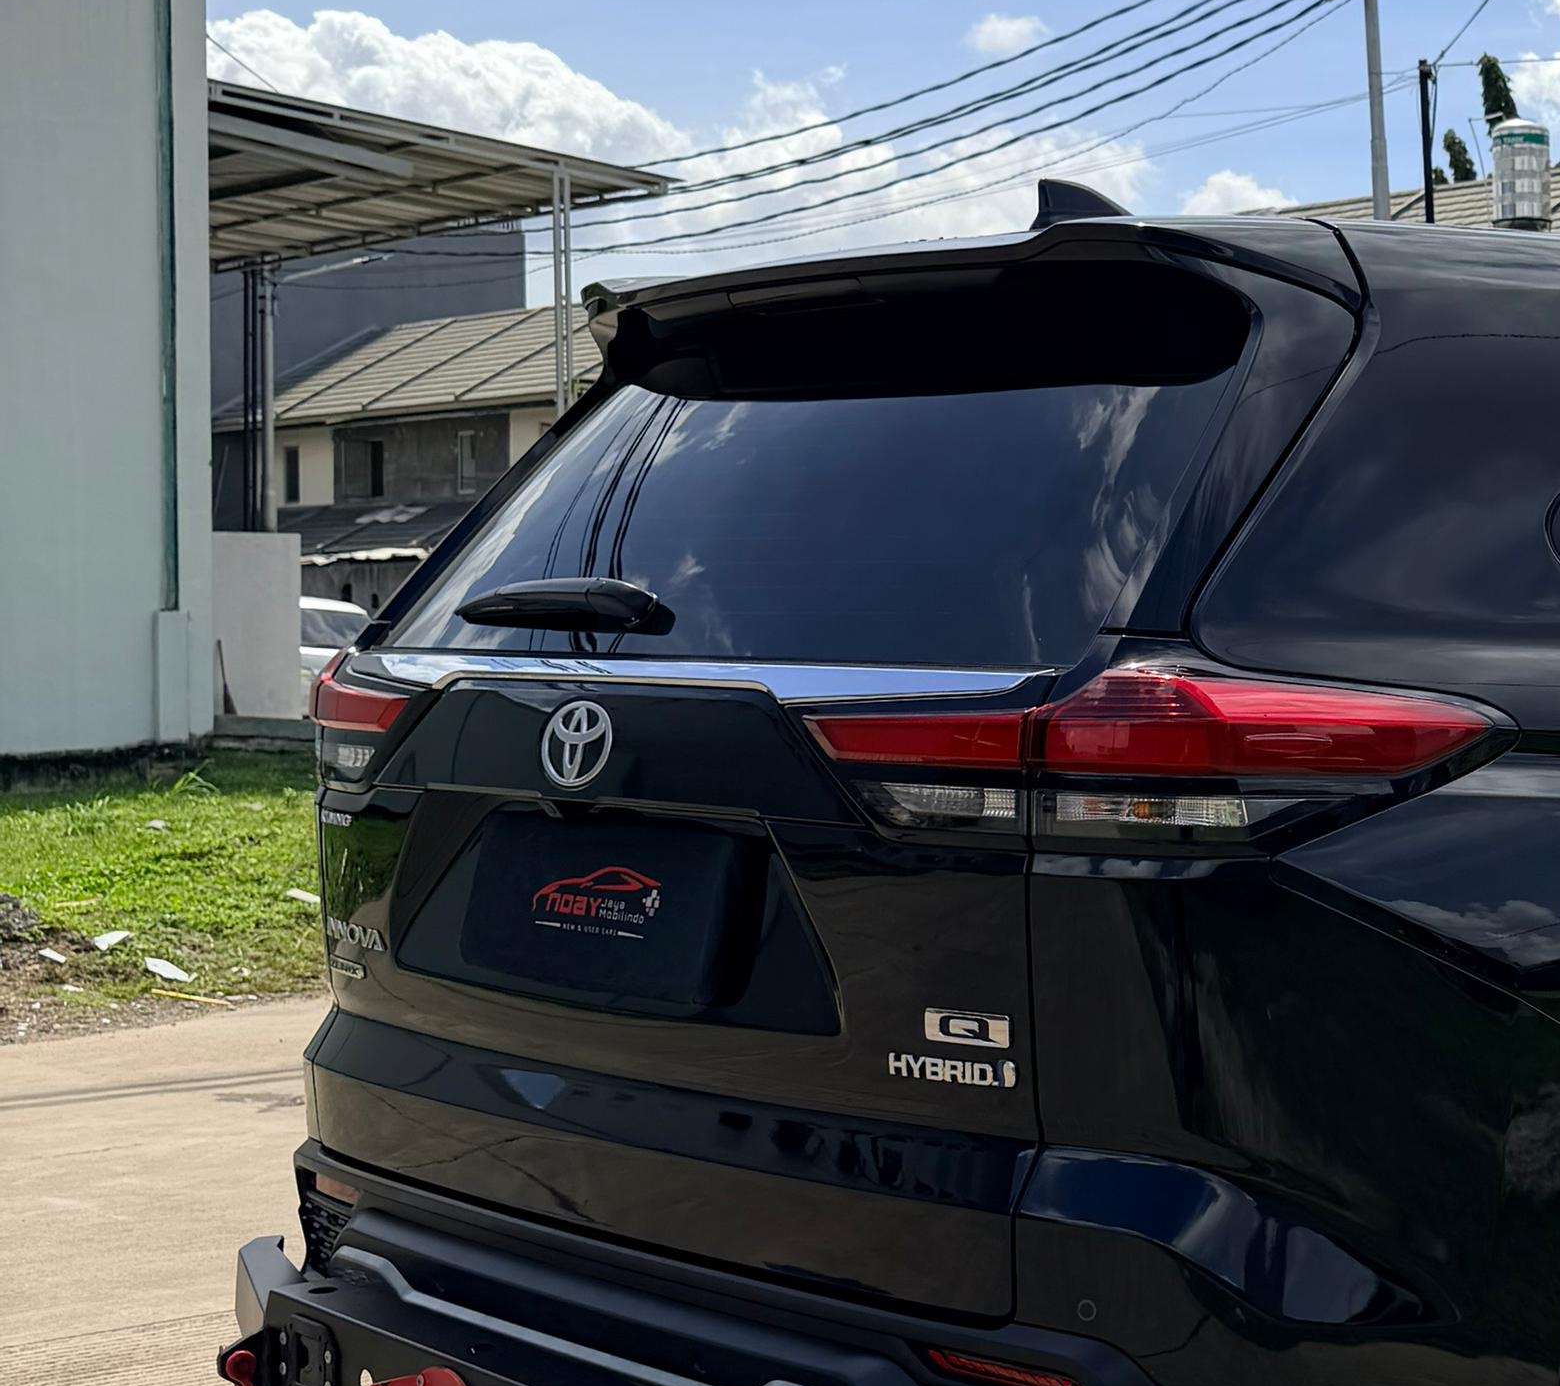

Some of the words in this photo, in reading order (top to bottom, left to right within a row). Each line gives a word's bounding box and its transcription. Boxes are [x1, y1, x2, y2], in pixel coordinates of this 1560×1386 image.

[600, 898, 625, 911] Jaya
[599, 909, 645, 925] Mobilindo
[888, 1052, 994, 1086] HYBRID
